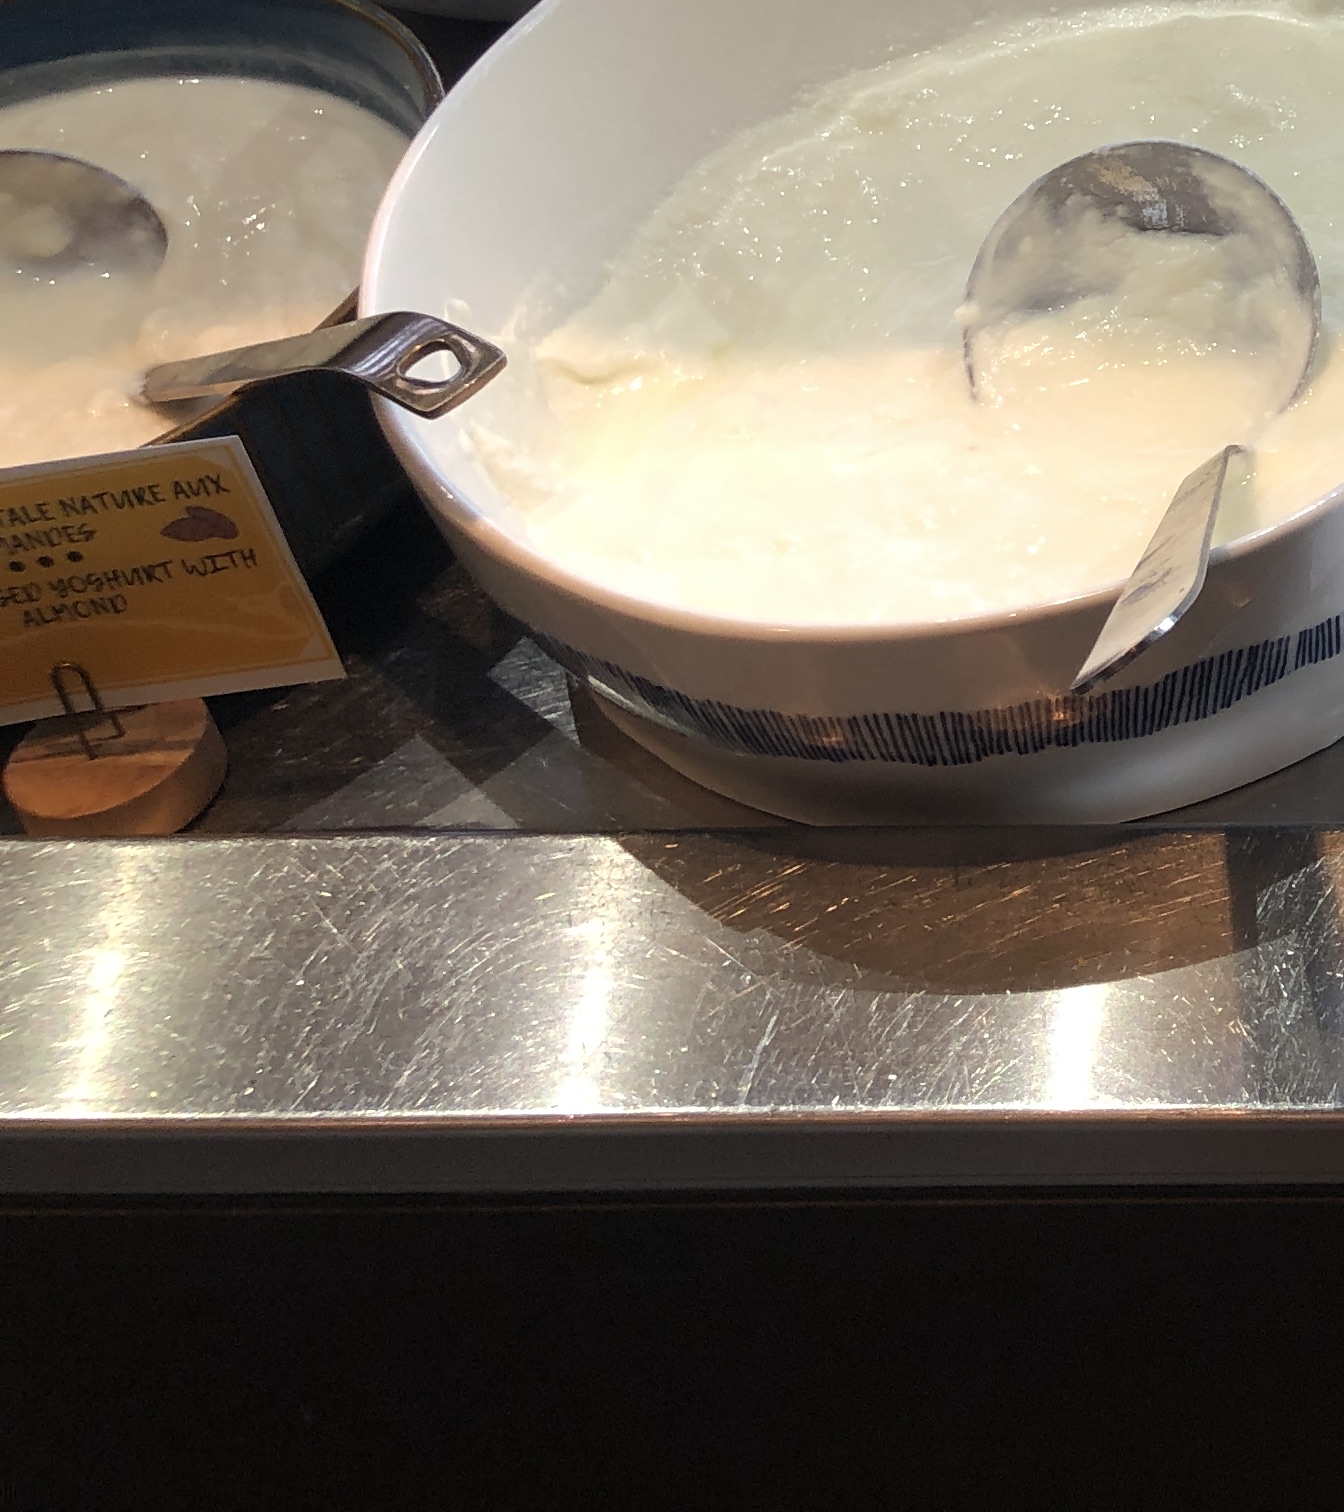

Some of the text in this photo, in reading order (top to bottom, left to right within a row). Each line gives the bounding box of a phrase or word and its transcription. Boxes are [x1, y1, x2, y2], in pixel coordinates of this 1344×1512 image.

[58, 483, 166, 518] NATURE
[172, 473, 231, 500] AUX
[181, 547, 258, 577] WITH
[22, 593, 128, 629] ALMOND
